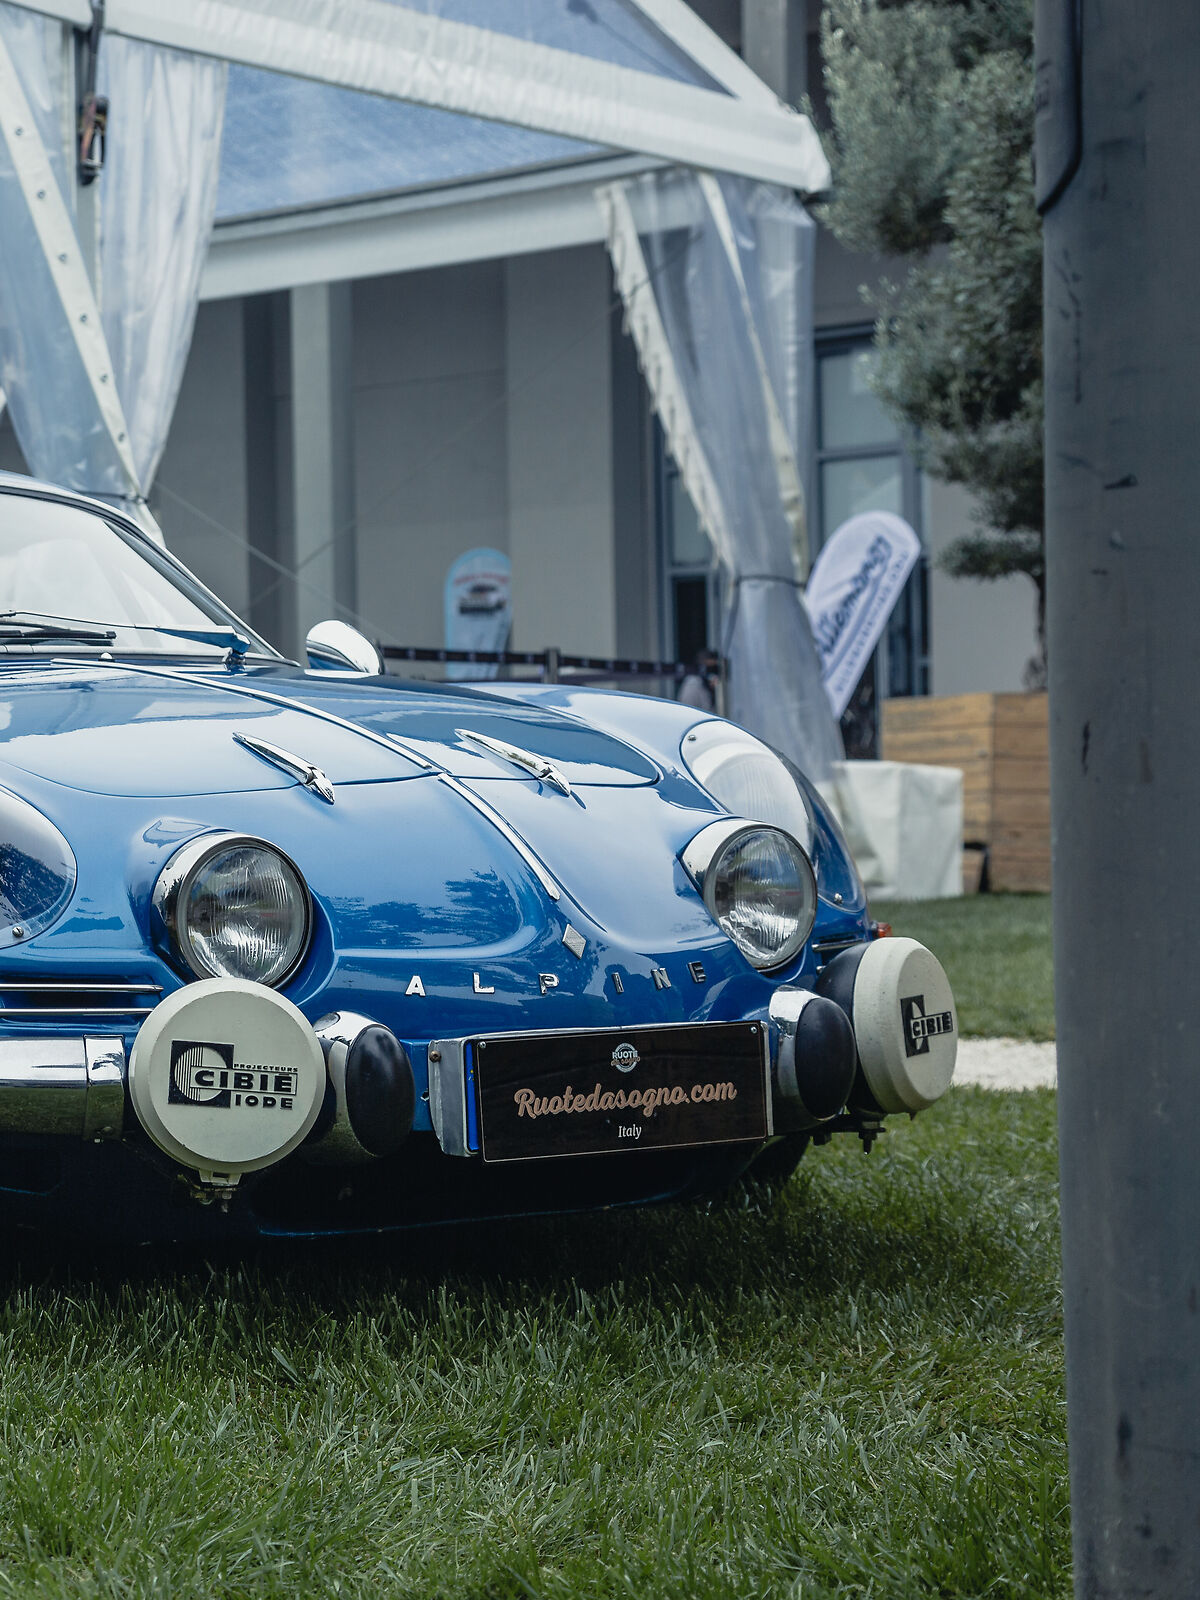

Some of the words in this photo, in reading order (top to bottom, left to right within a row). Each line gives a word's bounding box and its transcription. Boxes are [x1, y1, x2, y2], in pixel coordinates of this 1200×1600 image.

[405, 960, 707, 998] ALPINE
[234, 1063, 299, 1073] PROJECTEURS
[235, 1094, 294, 1110] IODE
[513, 1079, 738, 1119] Ruotedasogno.com
[617, 1124, 643, 1141] Italy
